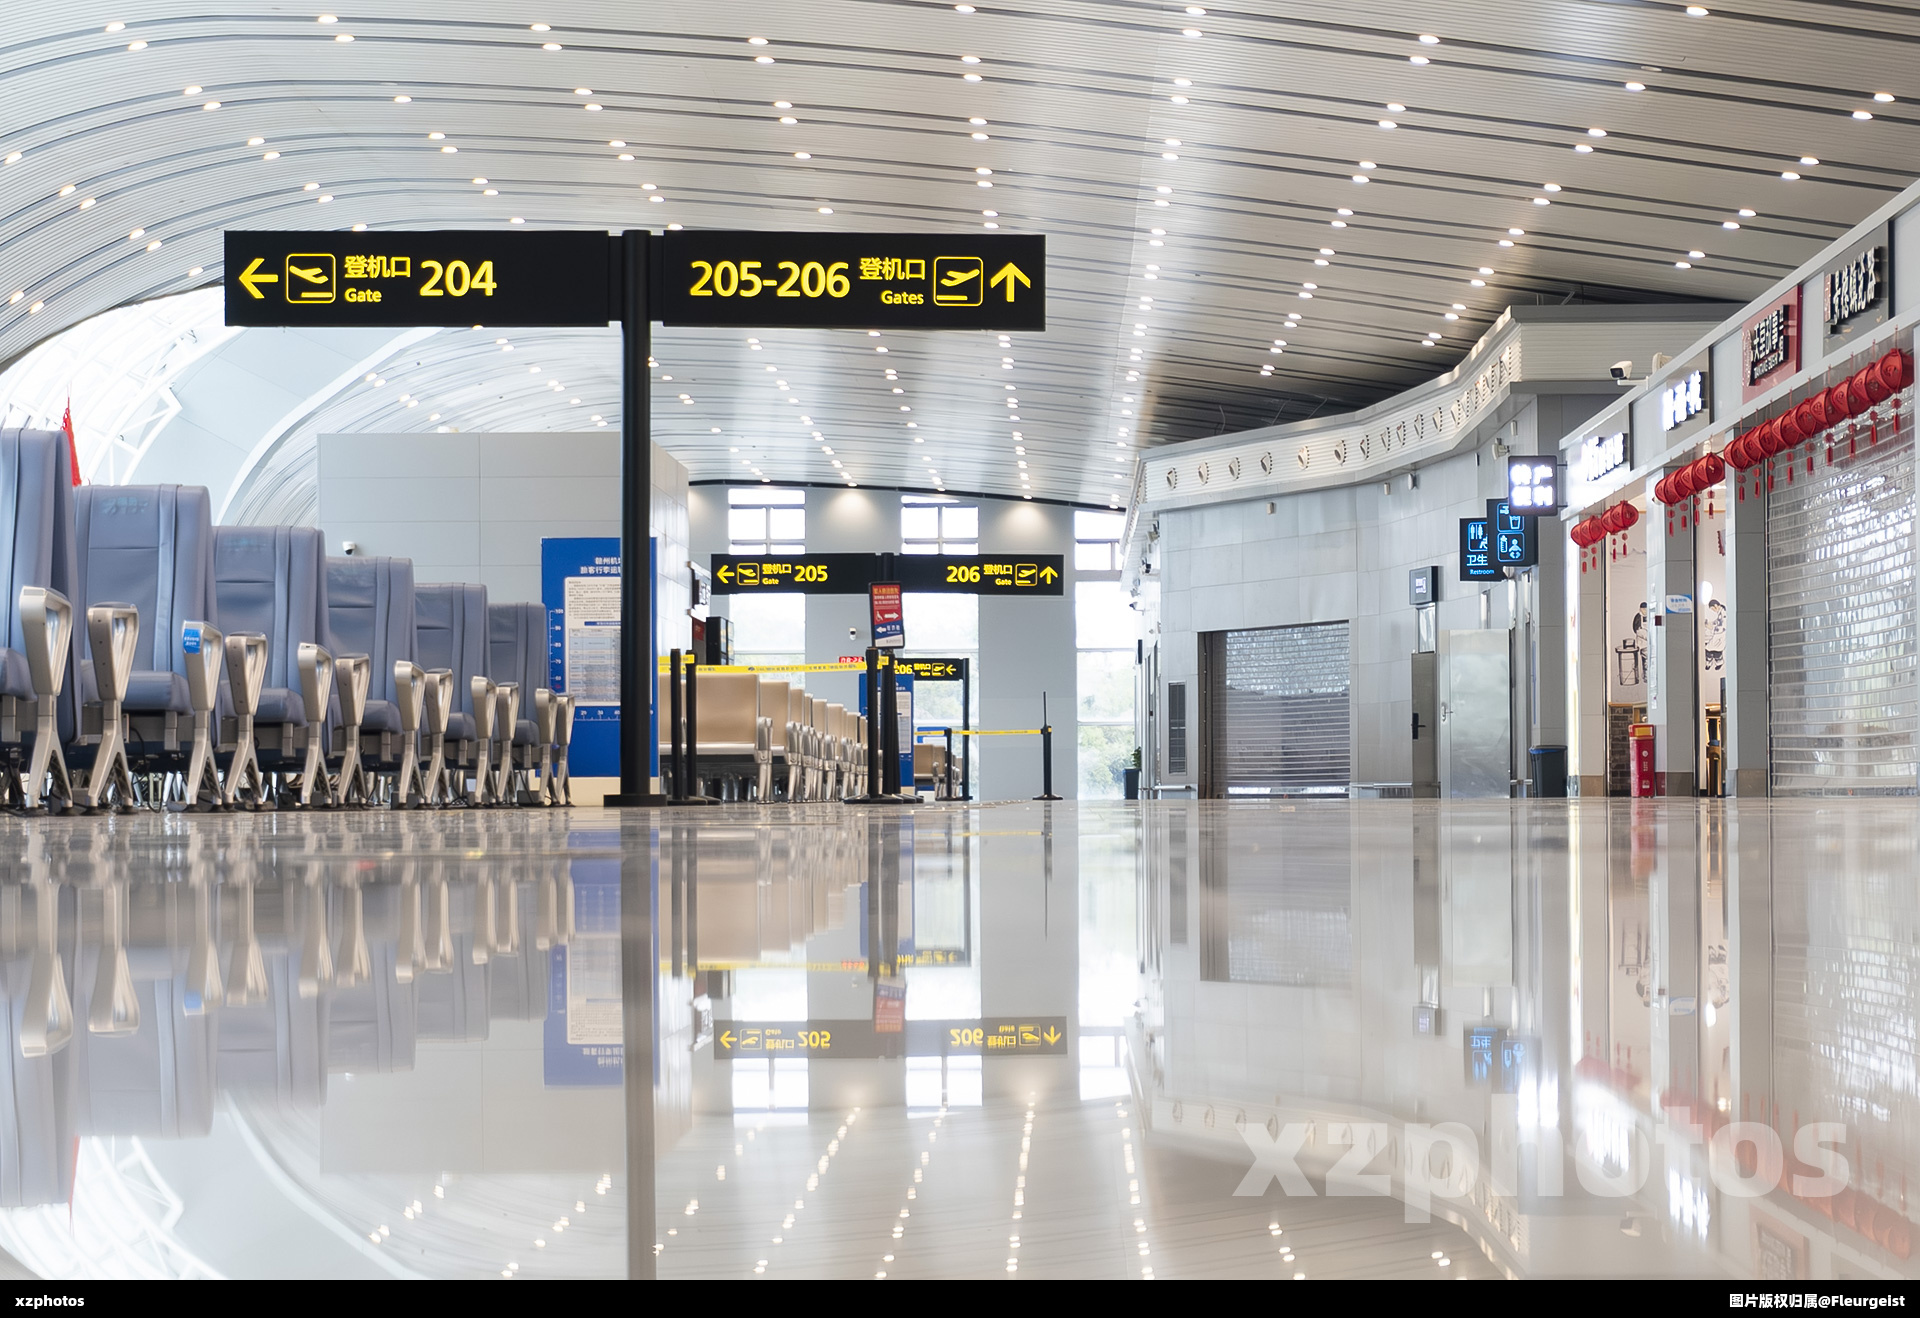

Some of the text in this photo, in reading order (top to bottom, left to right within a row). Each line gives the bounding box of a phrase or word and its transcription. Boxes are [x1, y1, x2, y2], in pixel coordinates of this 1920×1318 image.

[344, 255, 411, 279] 登机口
[859, 257, 926, 281] 登机口
[419, 260, 498, 297] 204
[689, 260, 851, 298] 205-206
[344, 287, 382, 303] Gate
[881, 290, 924, 305] Gates
[1466, 554, 1488, 567] 卫生
[762, 563, 792, 575] 登机口
[794, 565, 828, 582] 205
[946, 565, 980, 583] 206
[983, 563, 1013, 576] 登机口
[762, 577, 780, 585] Gate
[995, 577, 1012, 586] Gate
